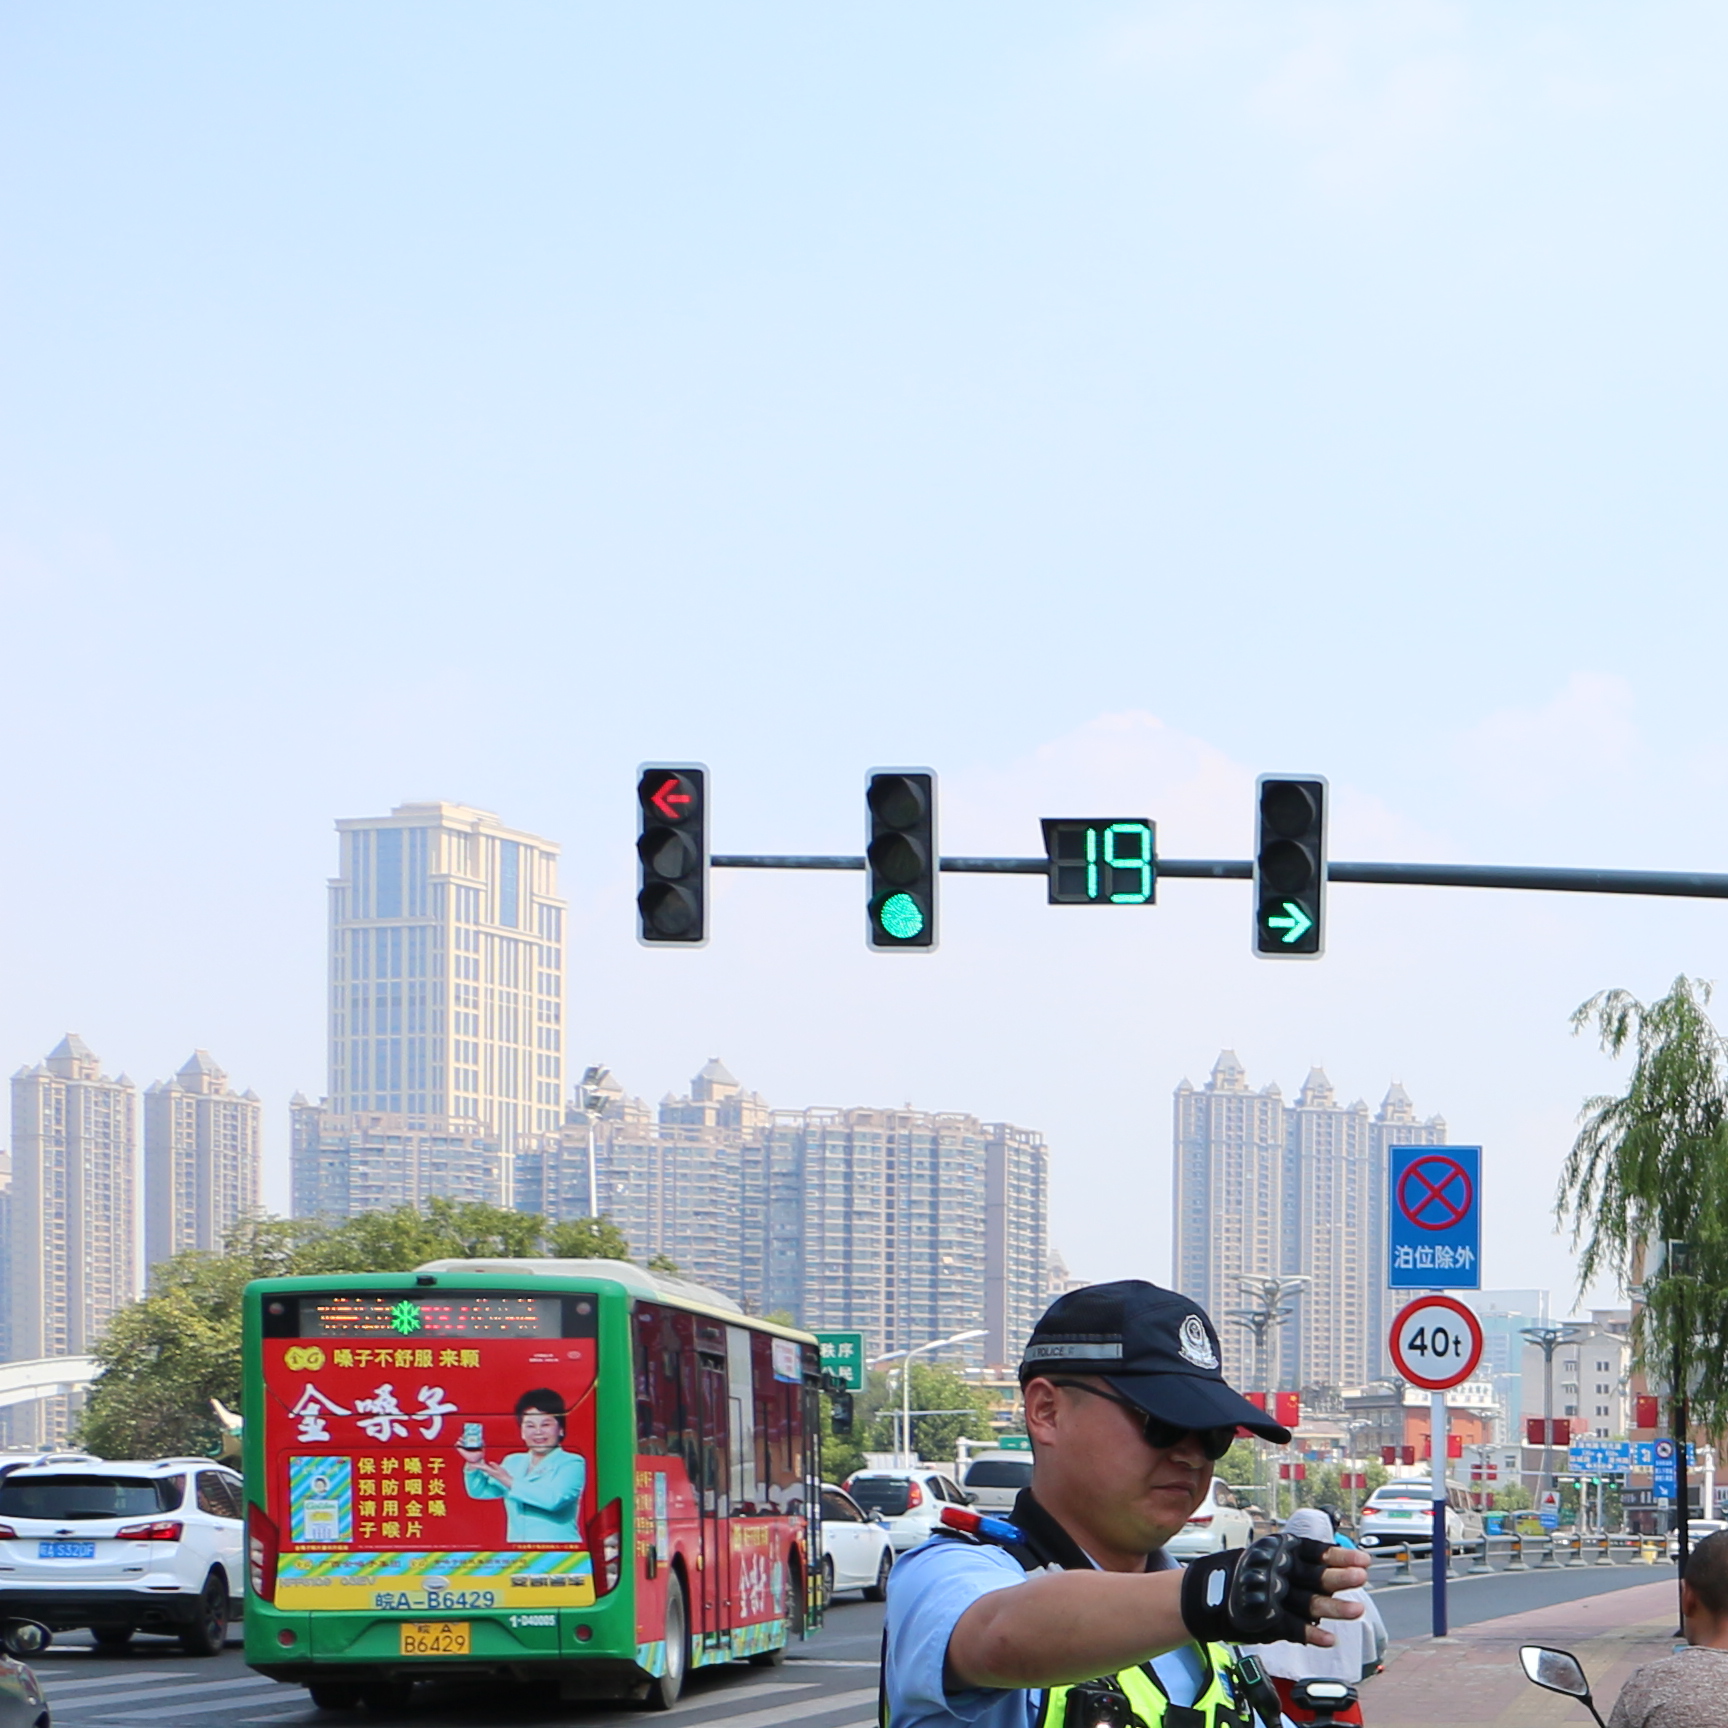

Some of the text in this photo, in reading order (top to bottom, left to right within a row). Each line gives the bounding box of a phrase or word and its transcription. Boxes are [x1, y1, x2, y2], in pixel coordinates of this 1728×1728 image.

[1084, 822, 1155, 905] 19
[1394, 1245, 1475, 1270] 泊位除外
[1408, 1326, 1461, 1358] 40t
[333, 1349, 480, 1369] 嗓子不舒服 来颗
[288, 1383, 458, 1443] 金嗓子
[357, 1457, 446, 1475] 保护嗓子
[358, 1478, 447, 1496] 预防咽炎
[358, 1499, 447, 1517] 请用金嗓
[358, 1521, 424, 1539] 子喉片
[403, 1635, 467, 1653] B6429
